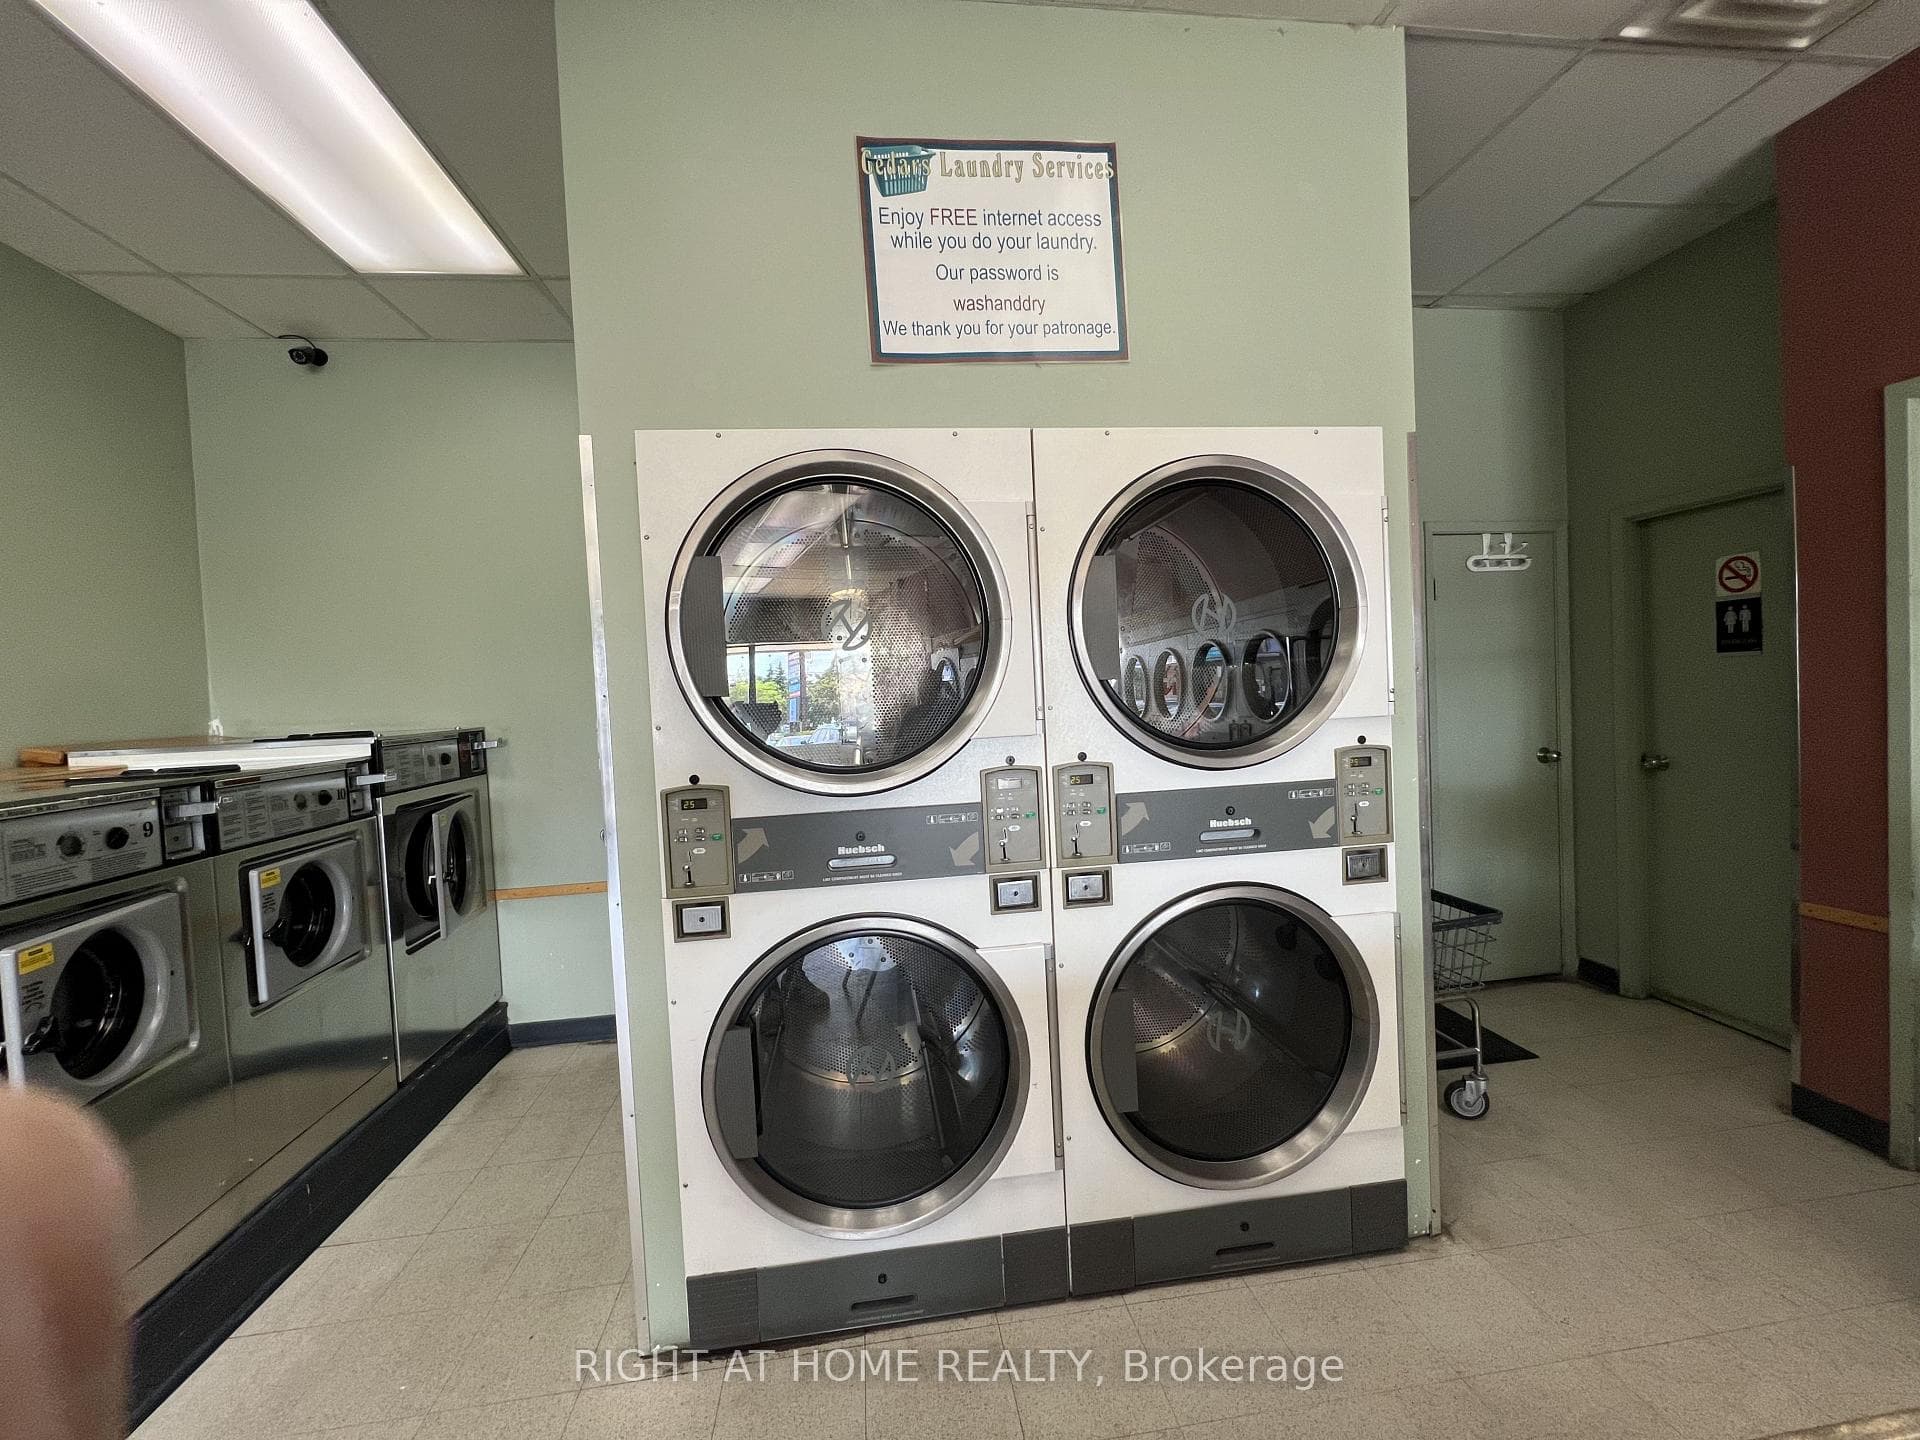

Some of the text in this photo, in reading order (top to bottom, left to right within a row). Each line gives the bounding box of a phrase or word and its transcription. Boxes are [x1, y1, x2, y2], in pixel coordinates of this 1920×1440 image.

[861, 148, 1114, 183] Cedars Laundry Services
[879, 207, 1102, 229] Enjoy FREE internet access
[891, 232, 1097, 253] while you do your laundry.
[936, 264, 1059, 284] Our password is
[953, 295, 1045, 315] washanddry
[883, 320, 1116, 338] We thank you for your patronage.
[337, 788, 346, 800] 10
[683, 800, 695, 809] 25
[142, 821, 154, 838] 9
